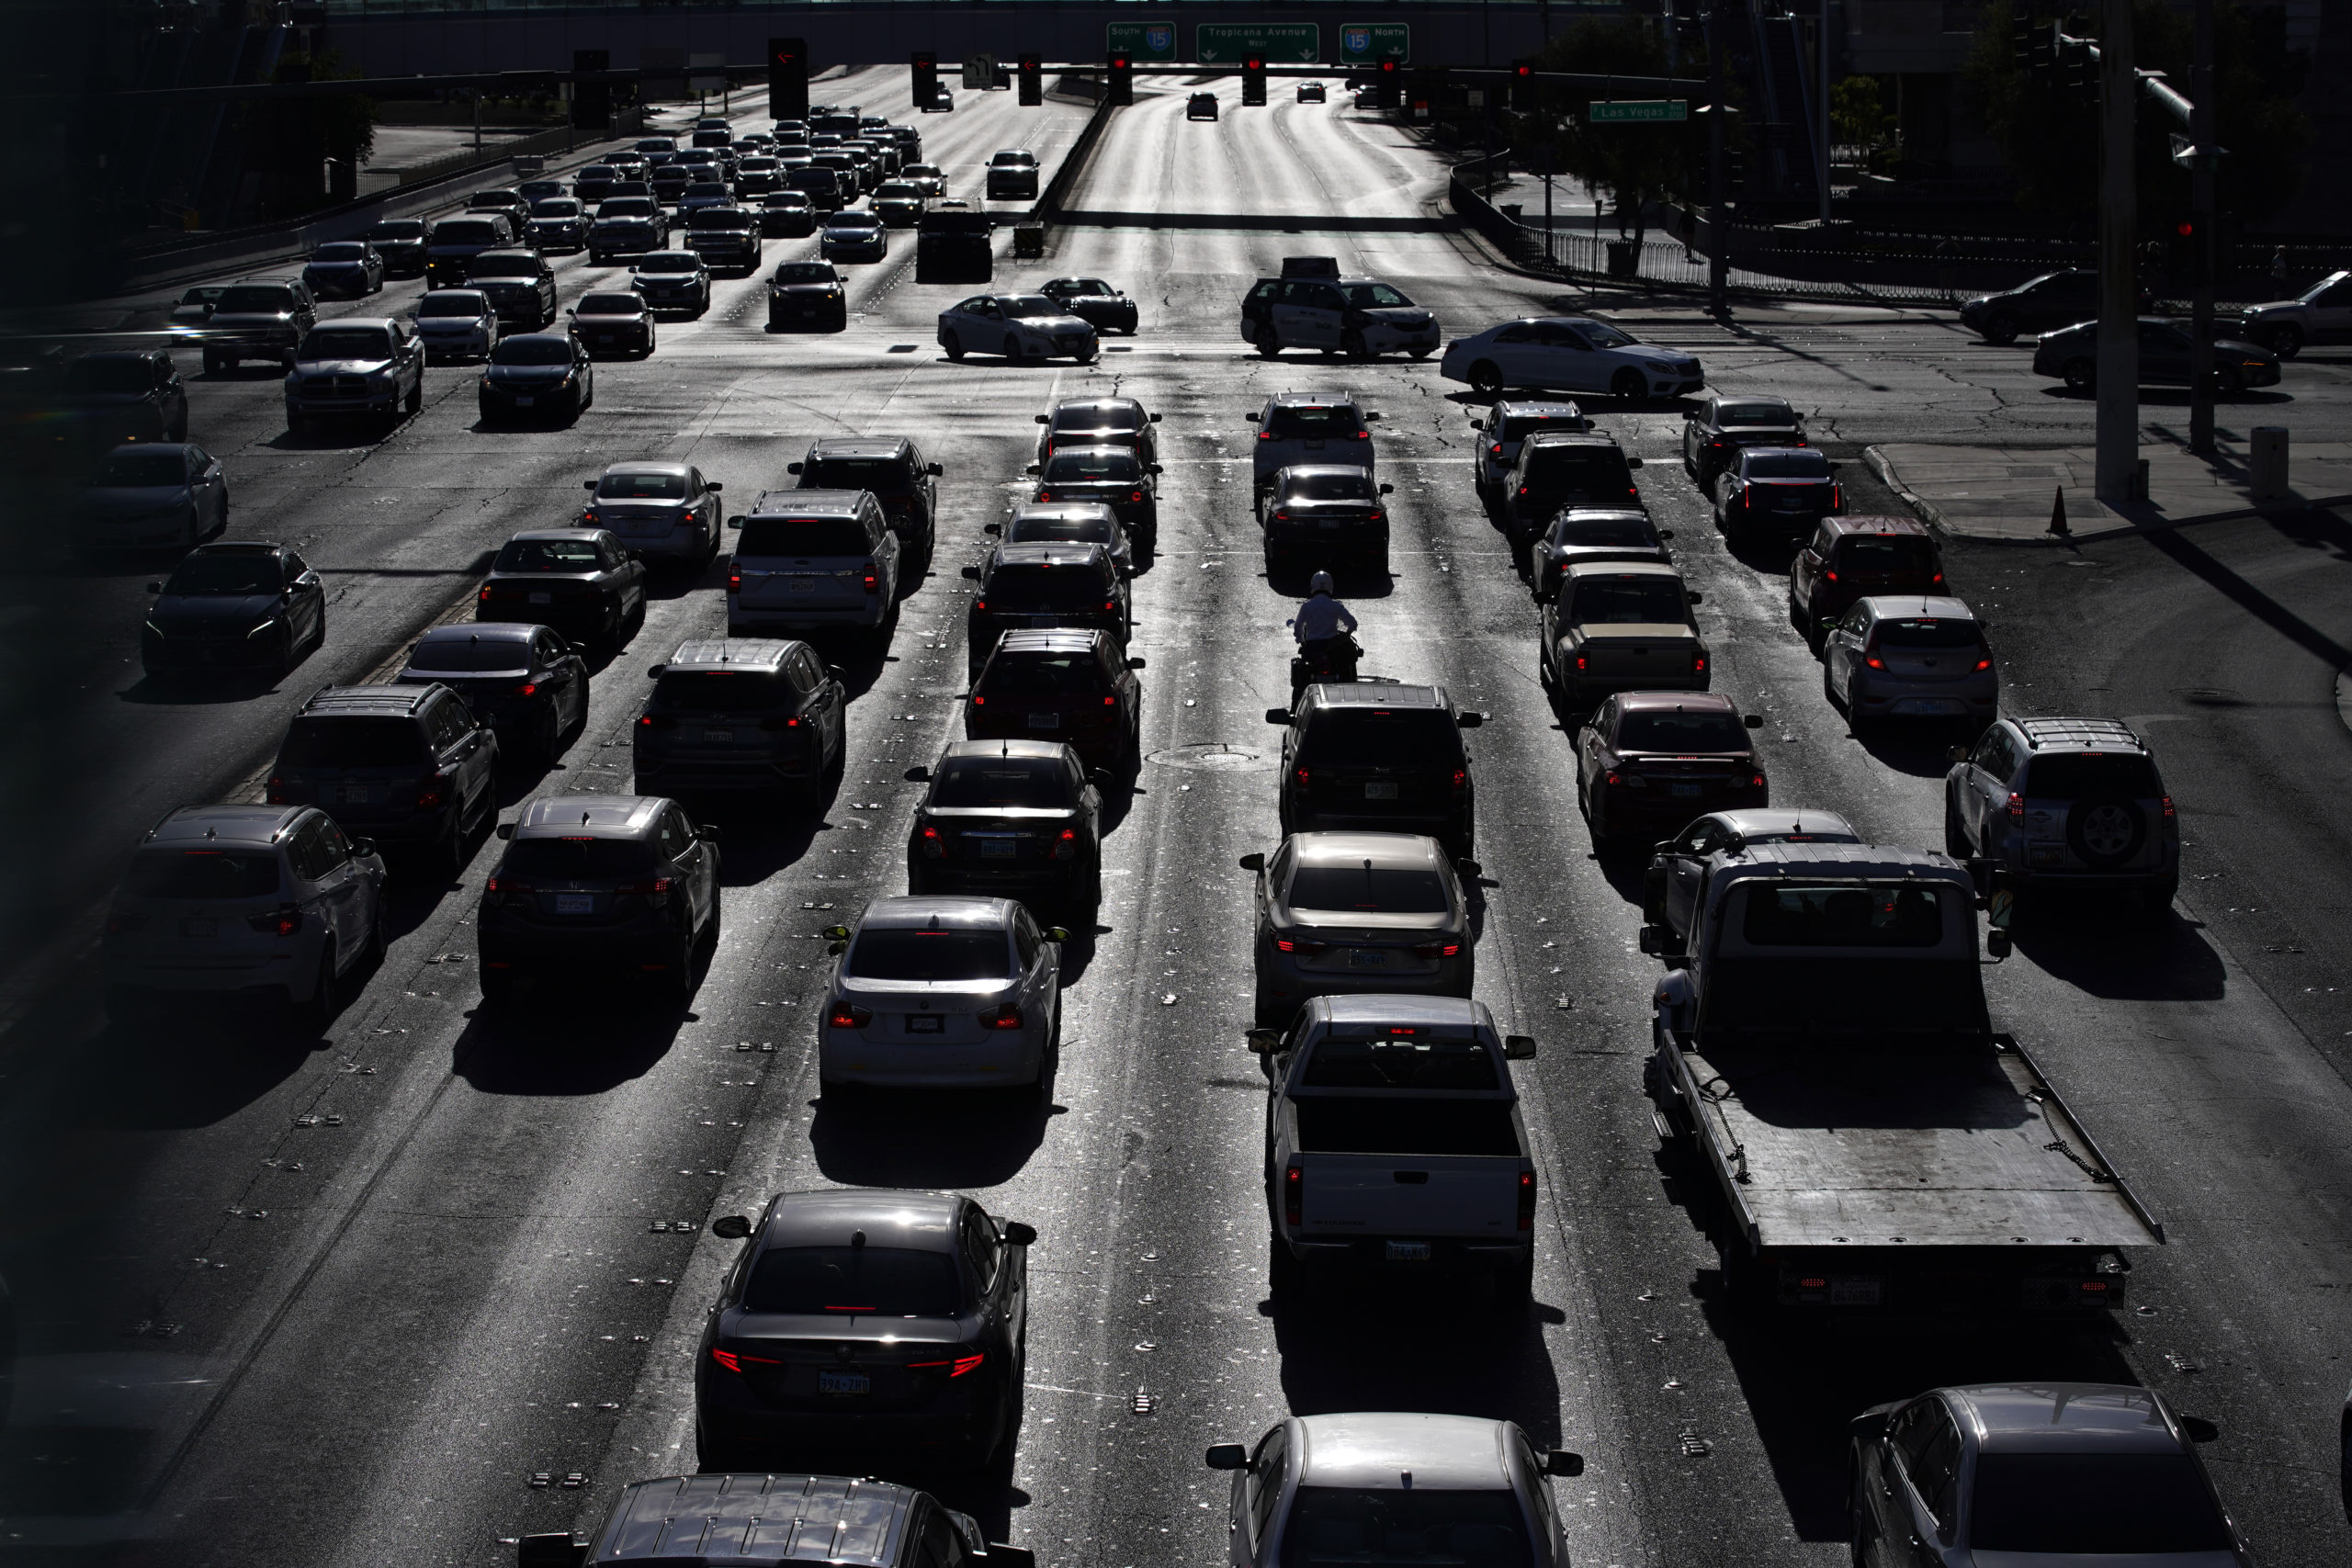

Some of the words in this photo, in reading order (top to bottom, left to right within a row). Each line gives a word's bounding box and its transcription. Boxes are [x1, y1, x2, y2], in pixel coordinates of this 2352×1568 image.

[1152, 31, 1166, 47] 15
[1208, 28, 1261, 38] Tropicana
[1267, 28, 1307, 37] Avenue
[1351, 34, 1365, 50] 15
[1601, 107, 1624, 118] Las
[1630, 106, 1664, 119] Vegas
